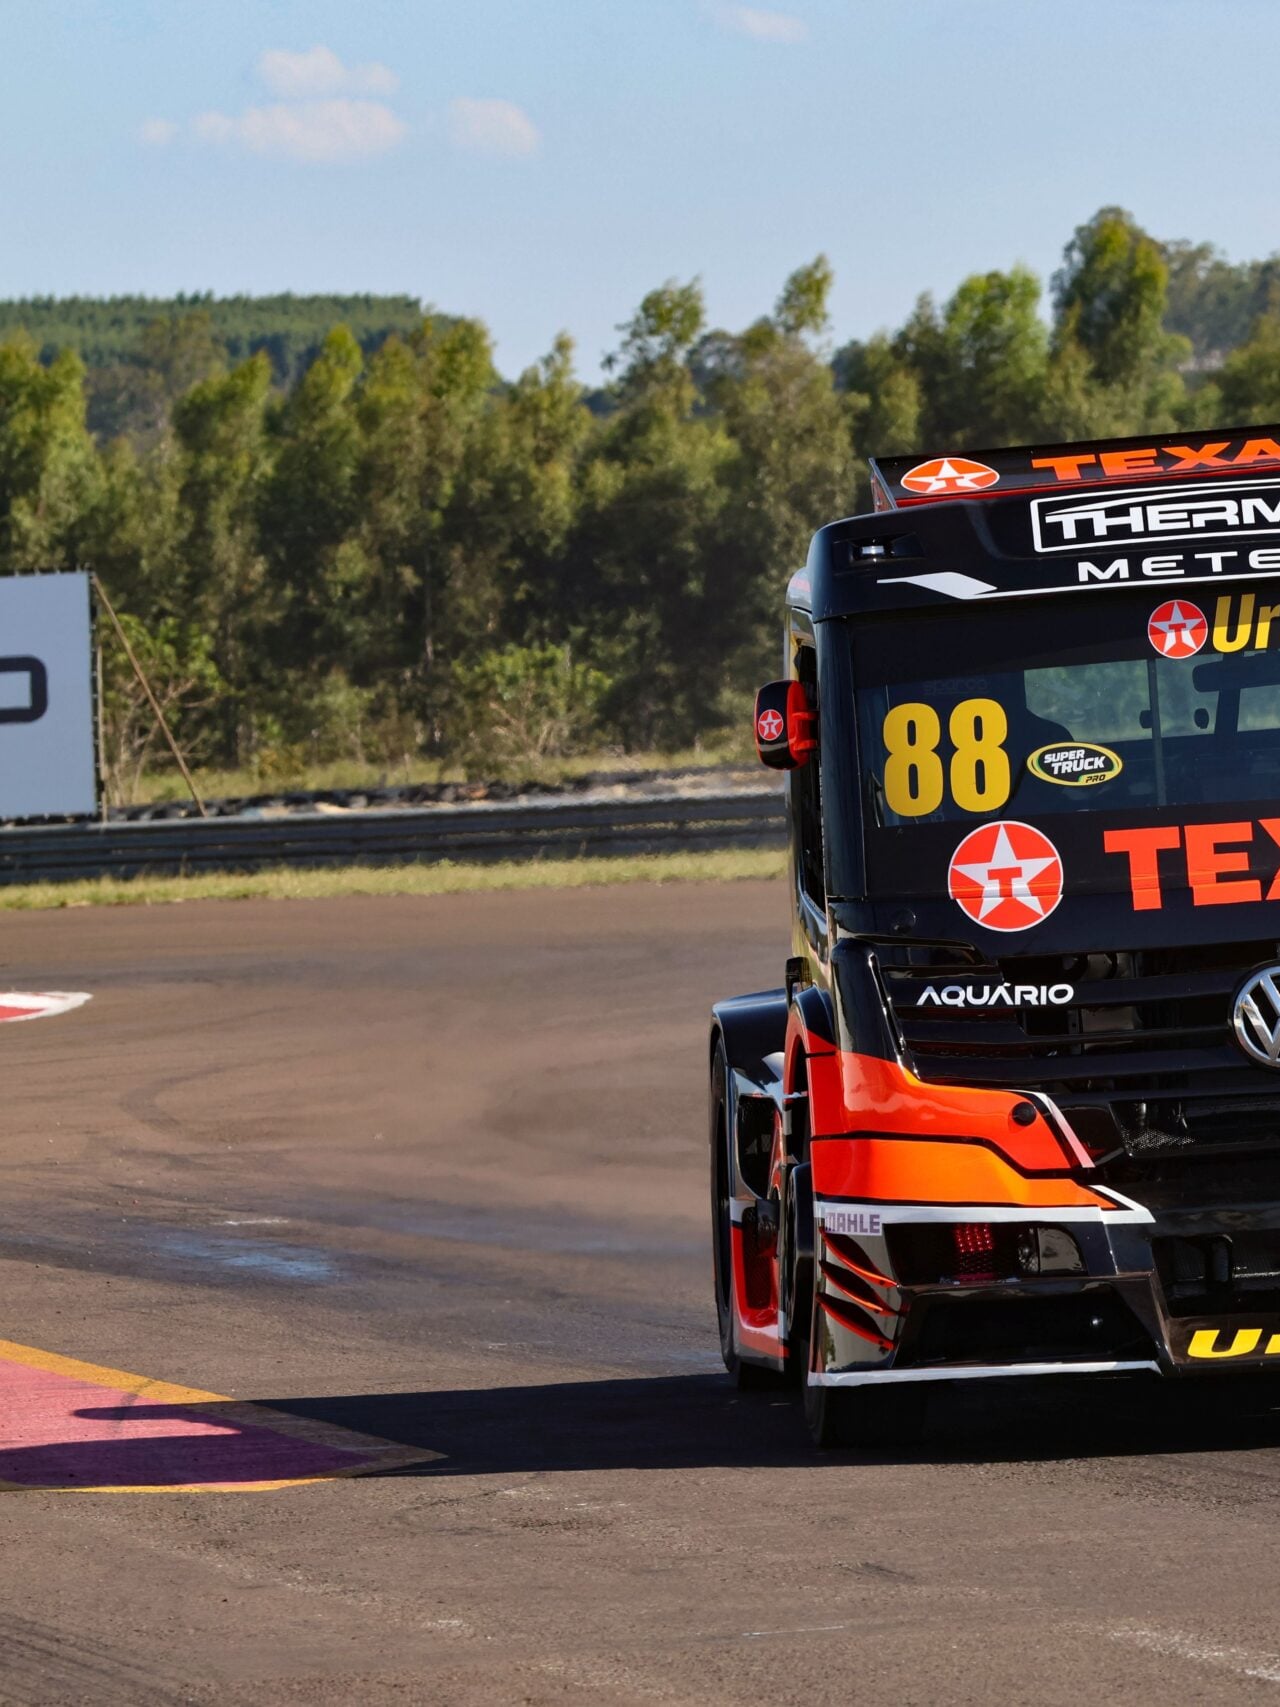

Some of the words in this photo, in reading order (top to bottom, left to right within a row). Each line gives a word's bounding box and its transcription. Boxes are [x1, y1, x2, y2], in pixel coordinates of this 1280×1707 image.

[883, 698, 1011, 817] 88
[1044, 749, 1086, 764] SUPER
[1051, 756, 1106, 775] TRUCK
[1085, 774, 1106, 784] PRO
[916, 982, 1075, 1008] AQUÁRIO
[825, 1212, 881, 1234] MAHLE
